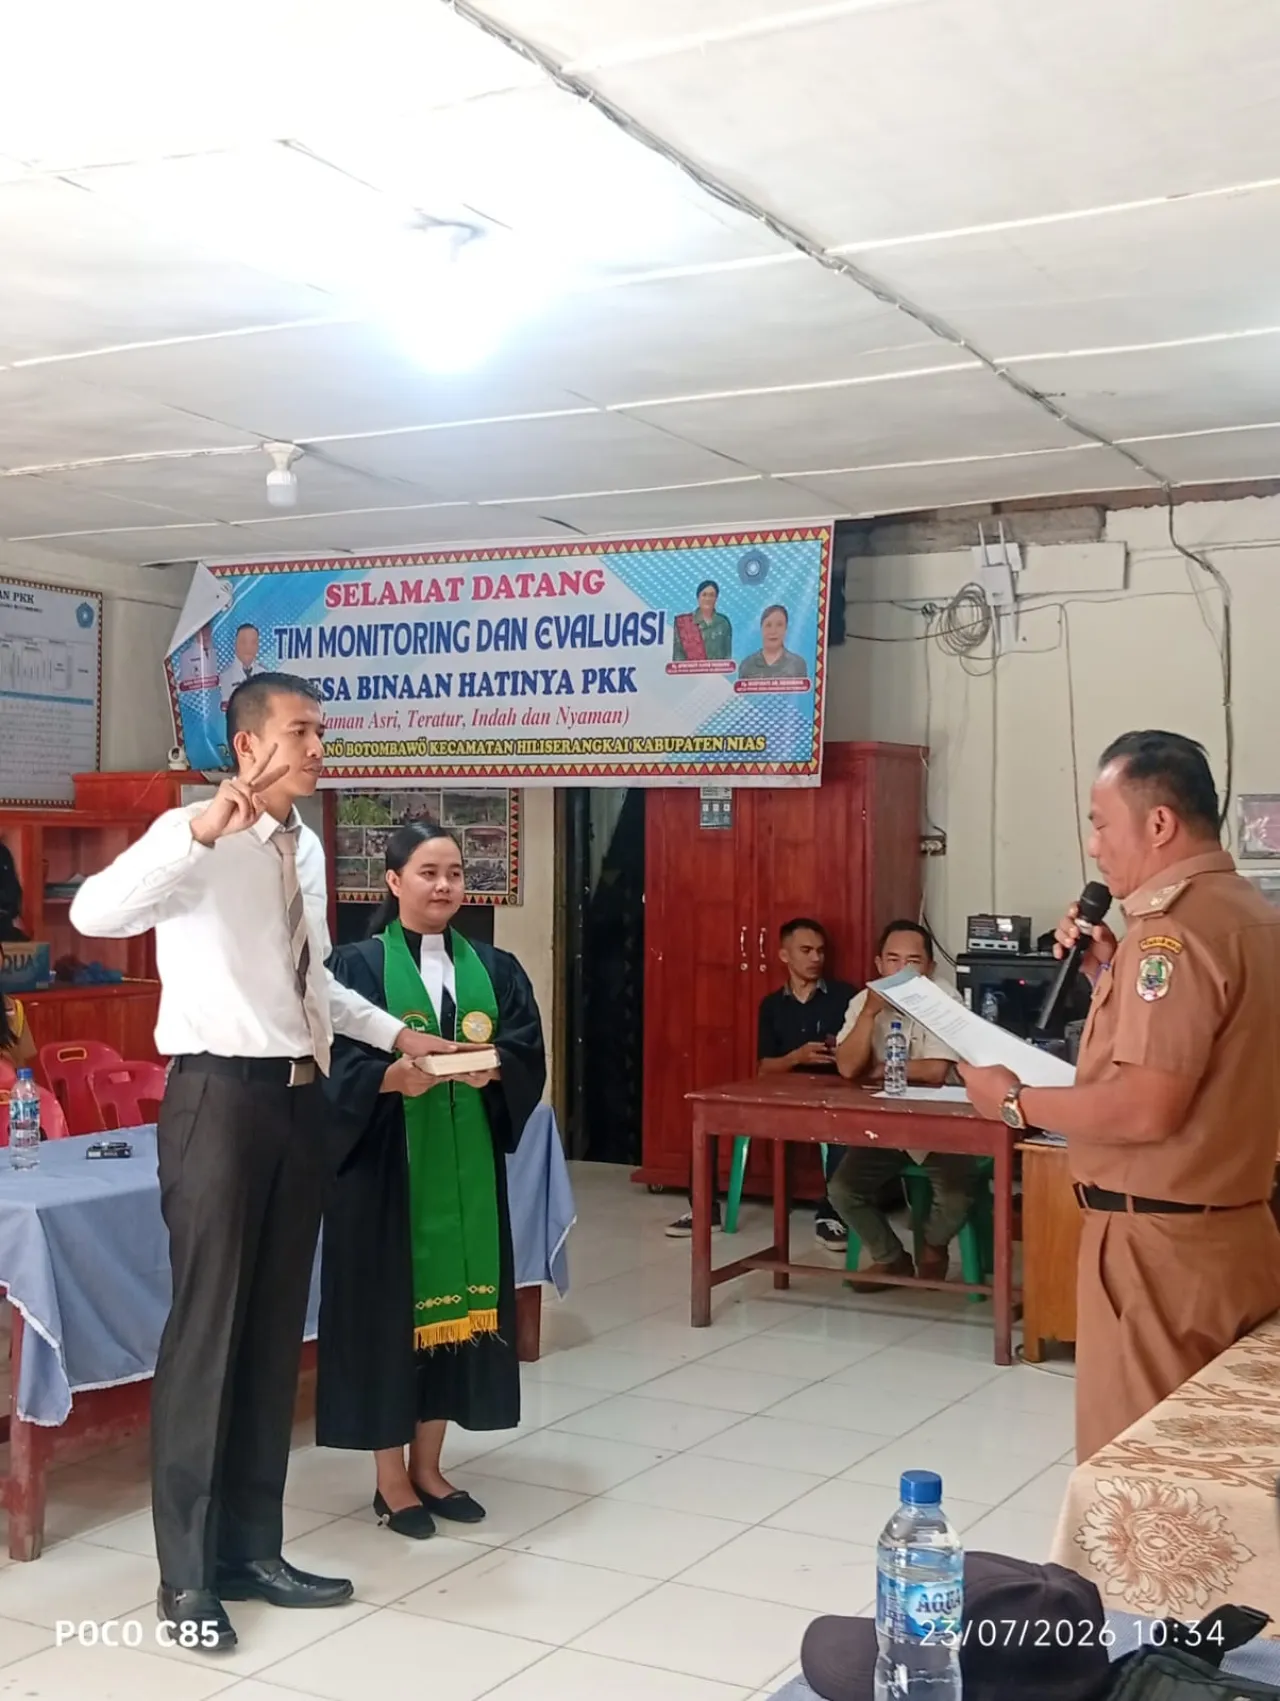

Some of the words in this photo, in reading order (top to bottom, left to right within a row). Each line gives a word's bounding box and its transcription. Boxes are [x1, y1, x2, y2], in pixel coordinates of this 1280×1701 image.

[13, 592, 34, 604] PKK
[325, 576, 465, 608] SELAMAT
[471, 569, 606, 600] DATANG
[273, 626, 312, 660] TIM
[318, 620, 470, 659] MONITORING
[476, 616, 528, 652] DAN
[534, 610, 666, 650] EVALUASI
[356, 672, 452, 701] BINAAN
[458, 669, 575, 699] HATINYA
[581, 666, 638, 695] PKK
[368, 710, 402, 732] Asri,
[407, 708, 467, 730] Teratur,
[471, 707, 517, 728] Indah
[521, 706, 551, 726] dan
[555, 705, 630, 730] Nyaman)
[346, 737, 428, 758] BOTOMBAWÖ
[428, 738, 515, 757] KECAMATAN
[516, 737, 632, 756] HILISERANGKAI
[631, 736, 726, 754] KABUPATEN
[725, 736, 767, 752] NIAS
